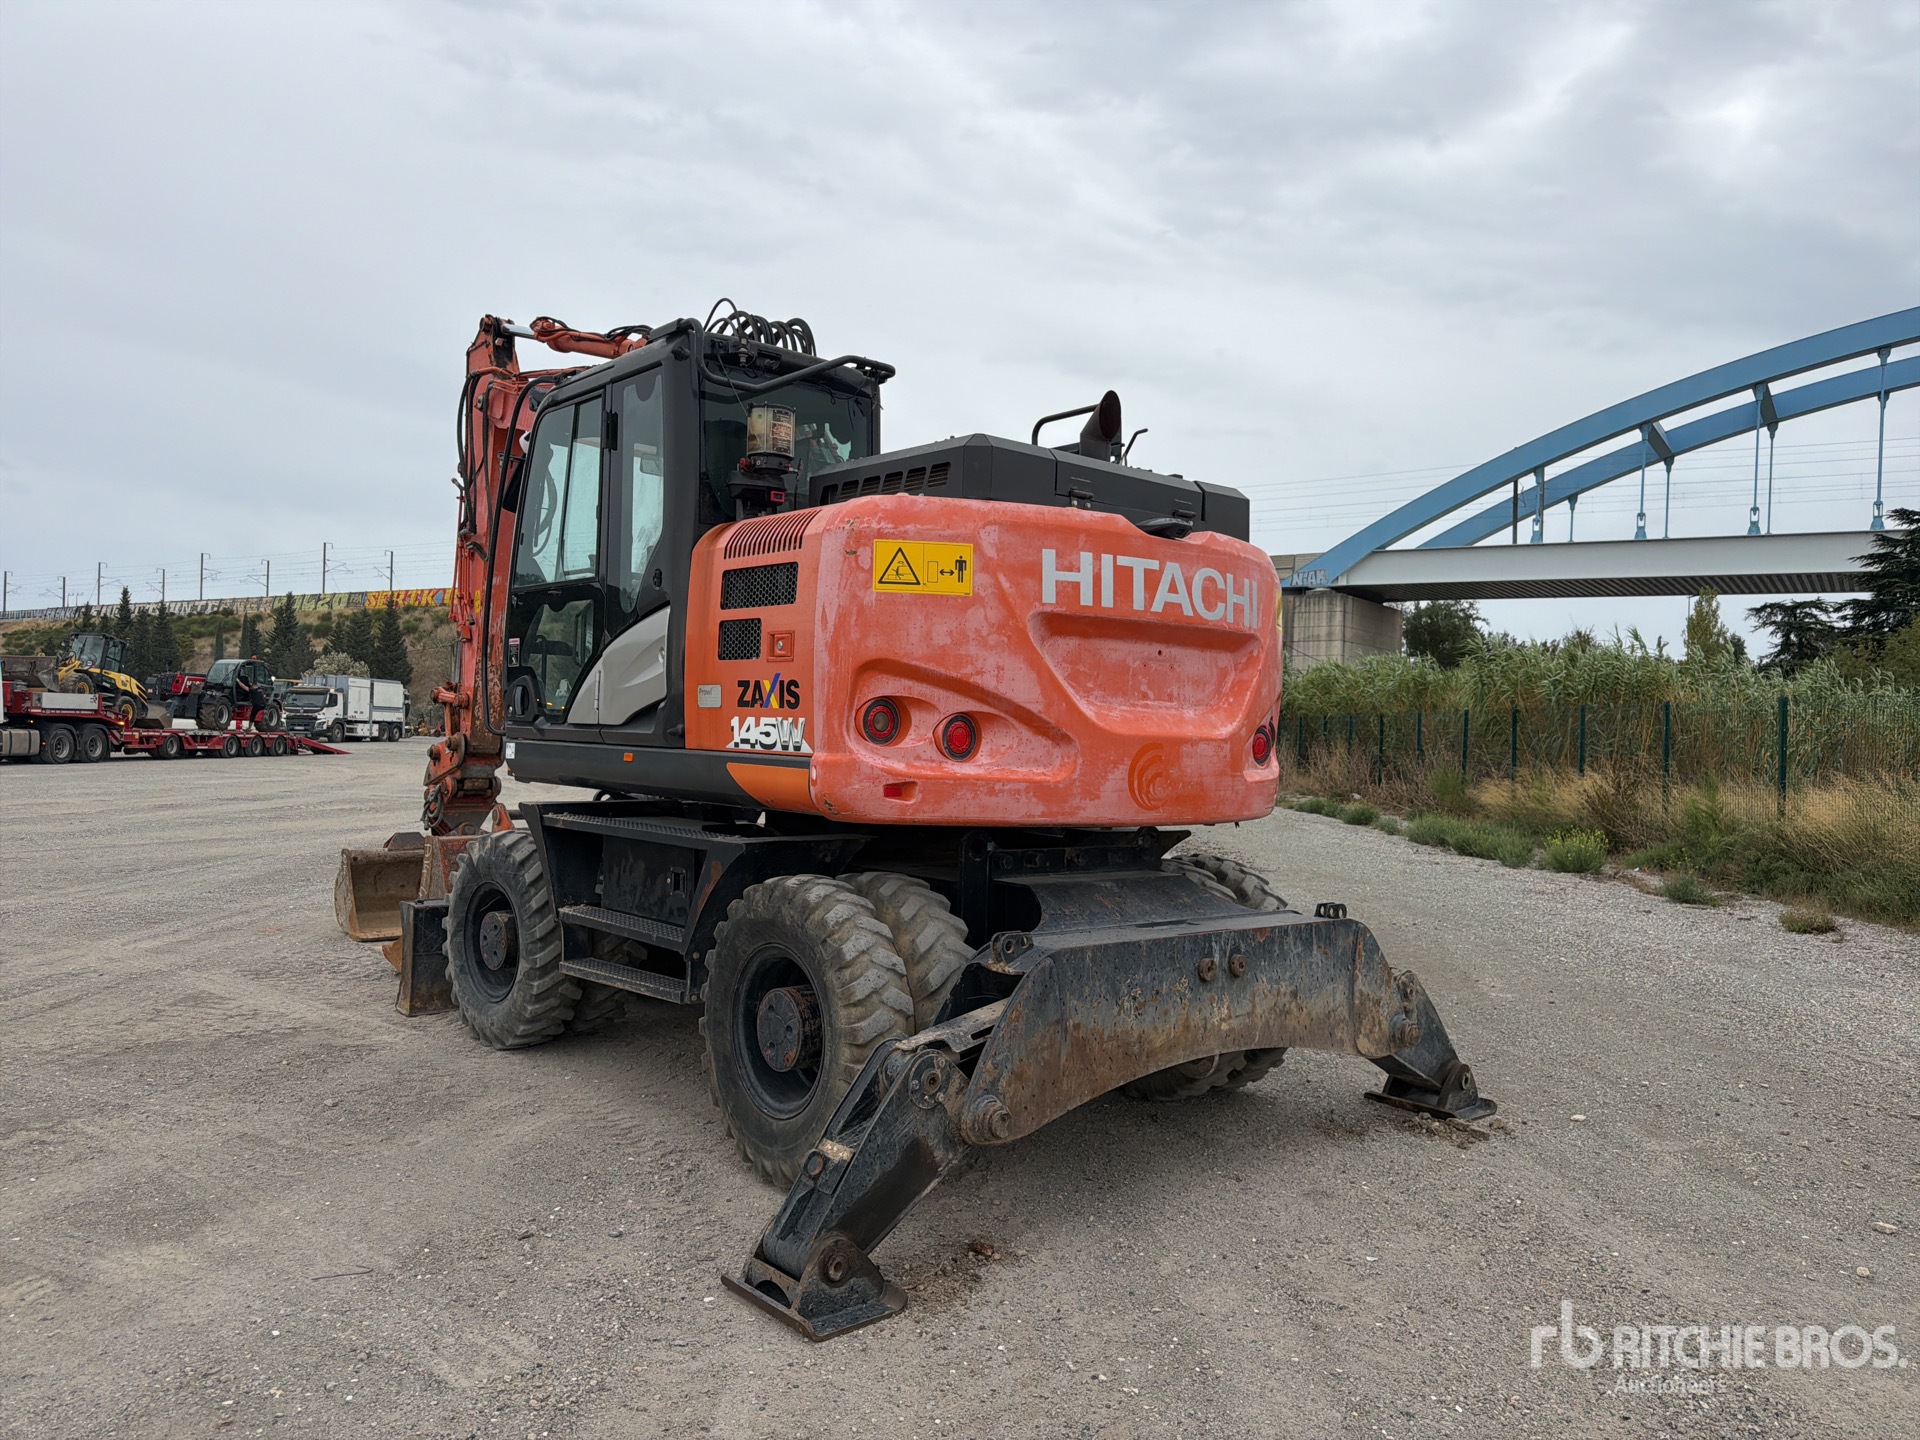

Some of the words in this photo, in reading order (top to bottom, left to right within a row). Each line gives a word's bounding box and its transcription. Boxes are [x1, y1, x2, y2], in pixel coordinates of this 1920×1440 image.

[1041, 548, 1259, 629] HITACHI
[737, 672, 801, 710] ZAXIS
[730, 716, 806, 751] 145W
